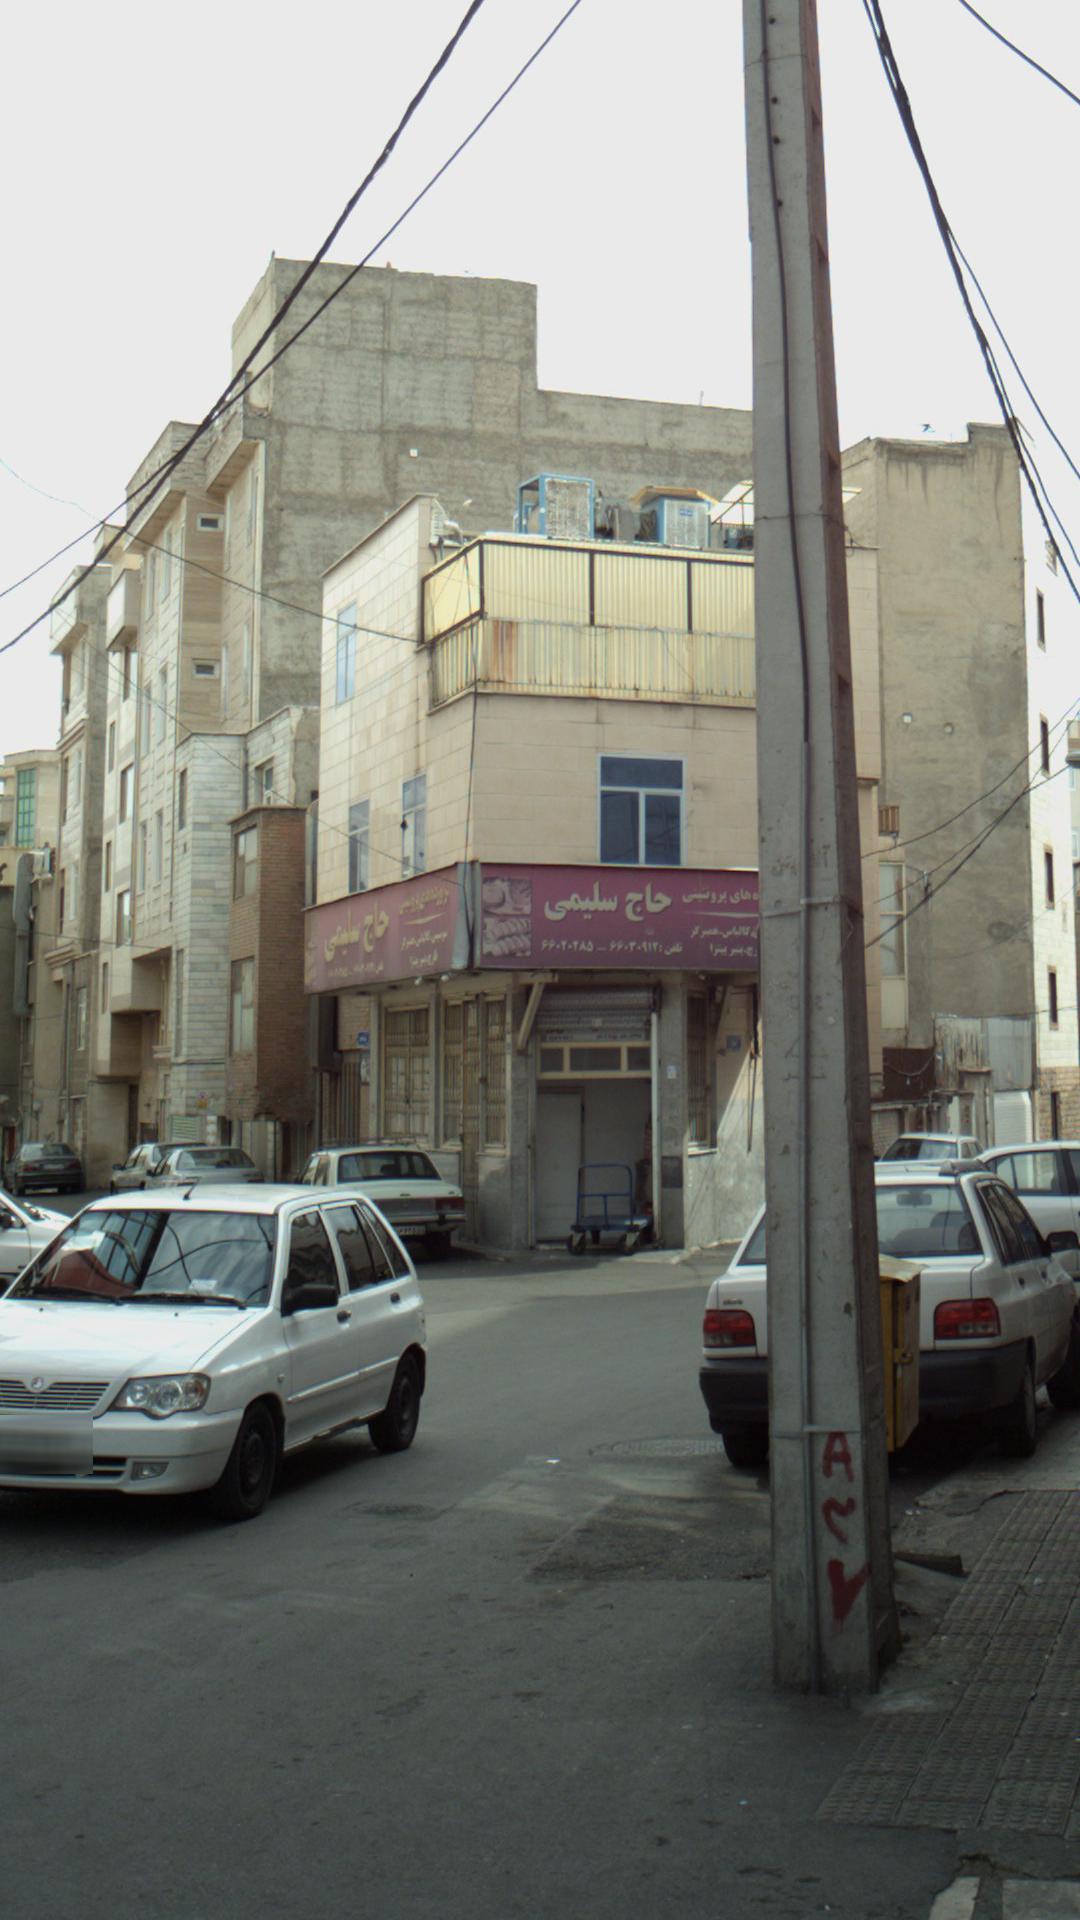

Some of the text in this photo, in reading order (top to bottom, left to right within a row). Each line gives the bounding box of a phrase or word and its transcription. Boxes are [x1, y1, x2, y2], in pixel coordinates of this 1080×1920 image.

[364, 898, 390, 952] حاج
[543, 881, 673, 922] حاج سلیمی
[324, 906, 361, 962] سلیمی
